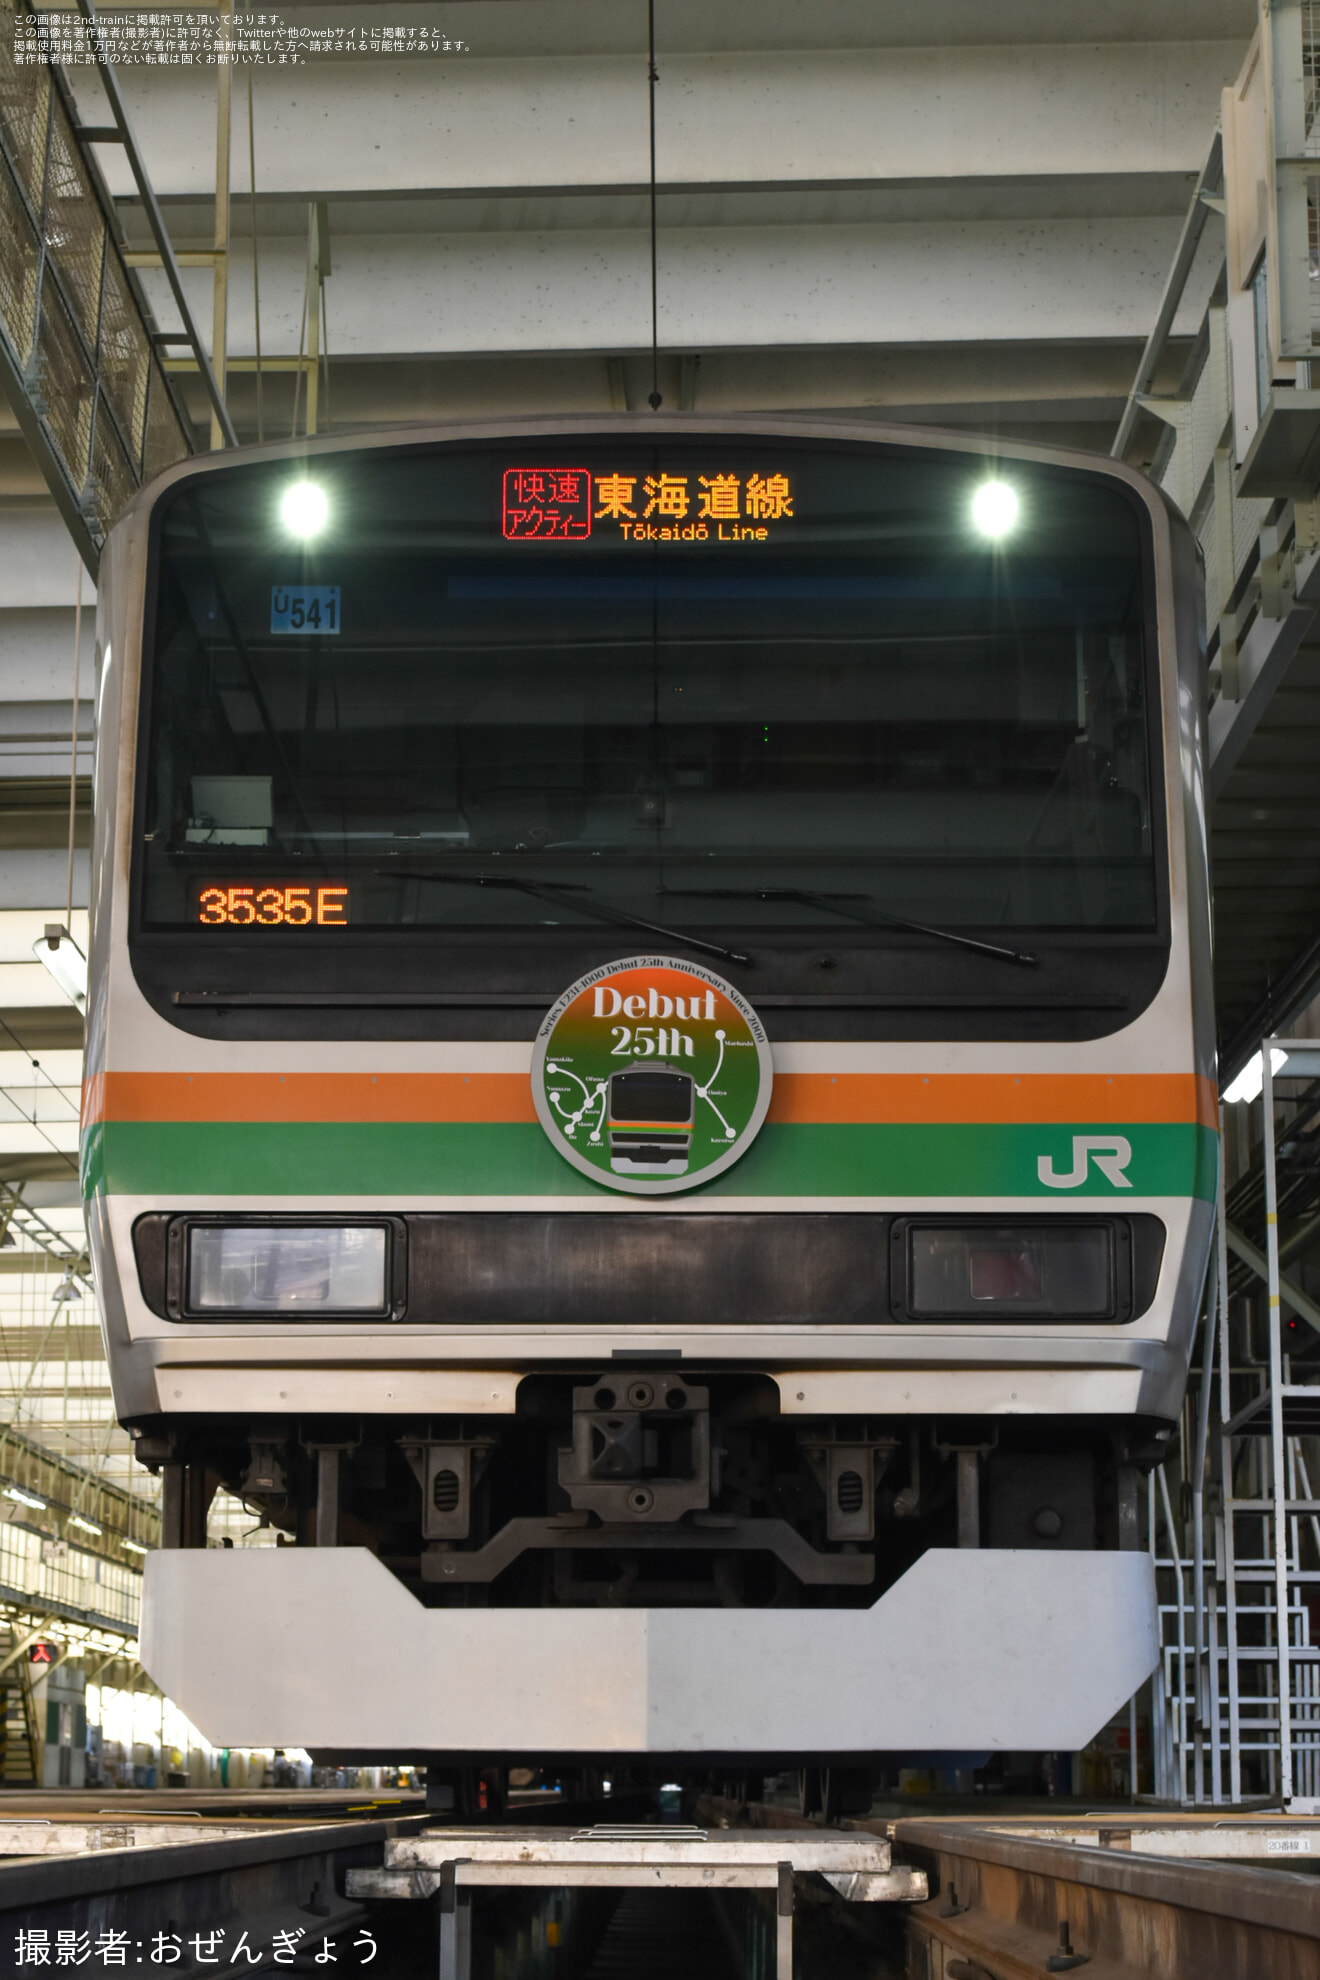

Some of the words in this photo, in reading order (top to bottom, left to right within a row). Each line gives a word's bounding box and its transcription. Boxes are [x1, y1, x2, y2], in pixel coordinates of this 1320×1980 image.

[514, 473, 580, 502] 快速
[594, 473, 794, 519] 東海道線
[507, 505, 587, 536] アクティー
[619, 523, 709, 541] Tōkaidō
[718, 523, 768, 541] Line
[199, 888, 348, 925] 3535E
[540, 1008, 562, 1037] Series
[606, 959, 638, 975] Debut
[640, 958, 664, 968] 25th
[666, 959, 727, 992] Anniversary
[729, 990, 750, 1015] Since
[748, 1016, 766, 1043] 2000
[592, 986, 718, 1020] Debut
[610, 1026, 695, 1057] 25th
[1037, 1136, 1133, 1189] JR
